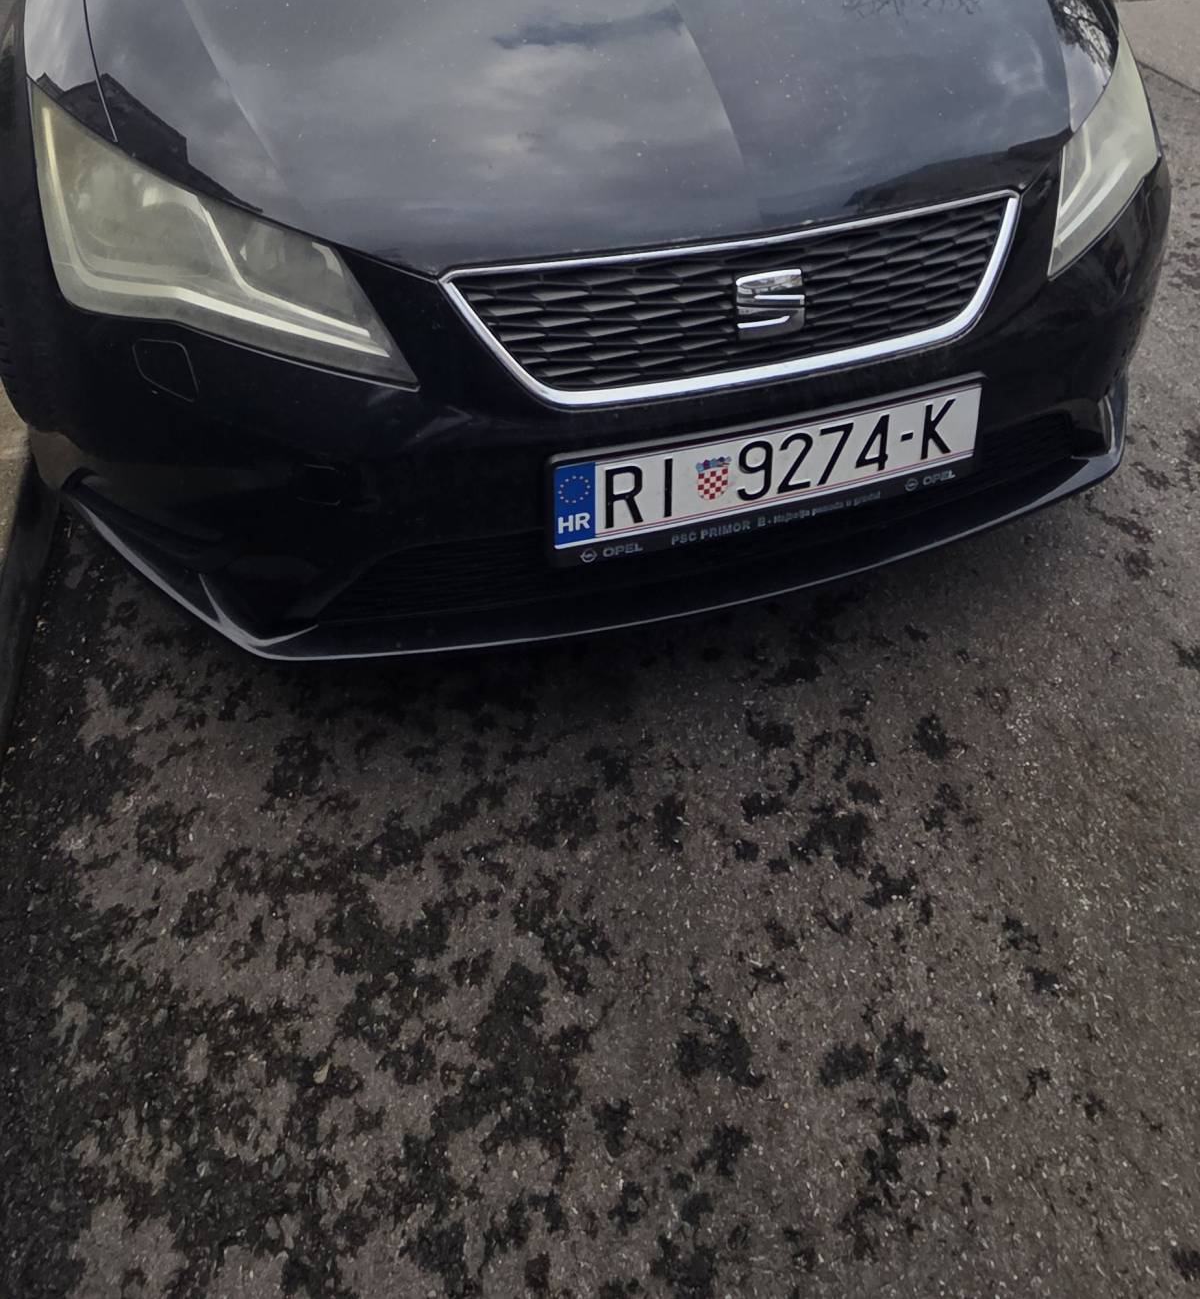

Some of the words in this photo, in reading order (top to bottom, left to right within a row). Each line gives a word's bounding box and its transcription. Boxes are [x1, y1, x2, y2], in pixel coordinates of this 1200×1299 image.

[604, 458, 673, 529] RI
[737, 398, 957, 502] 9274-K
[922, 469, 957, 486] OPEL
[557, 512, 591, 534] HR
[671, 532, 698, 546] PSC
[602, 542, 644, 558] OPEL
